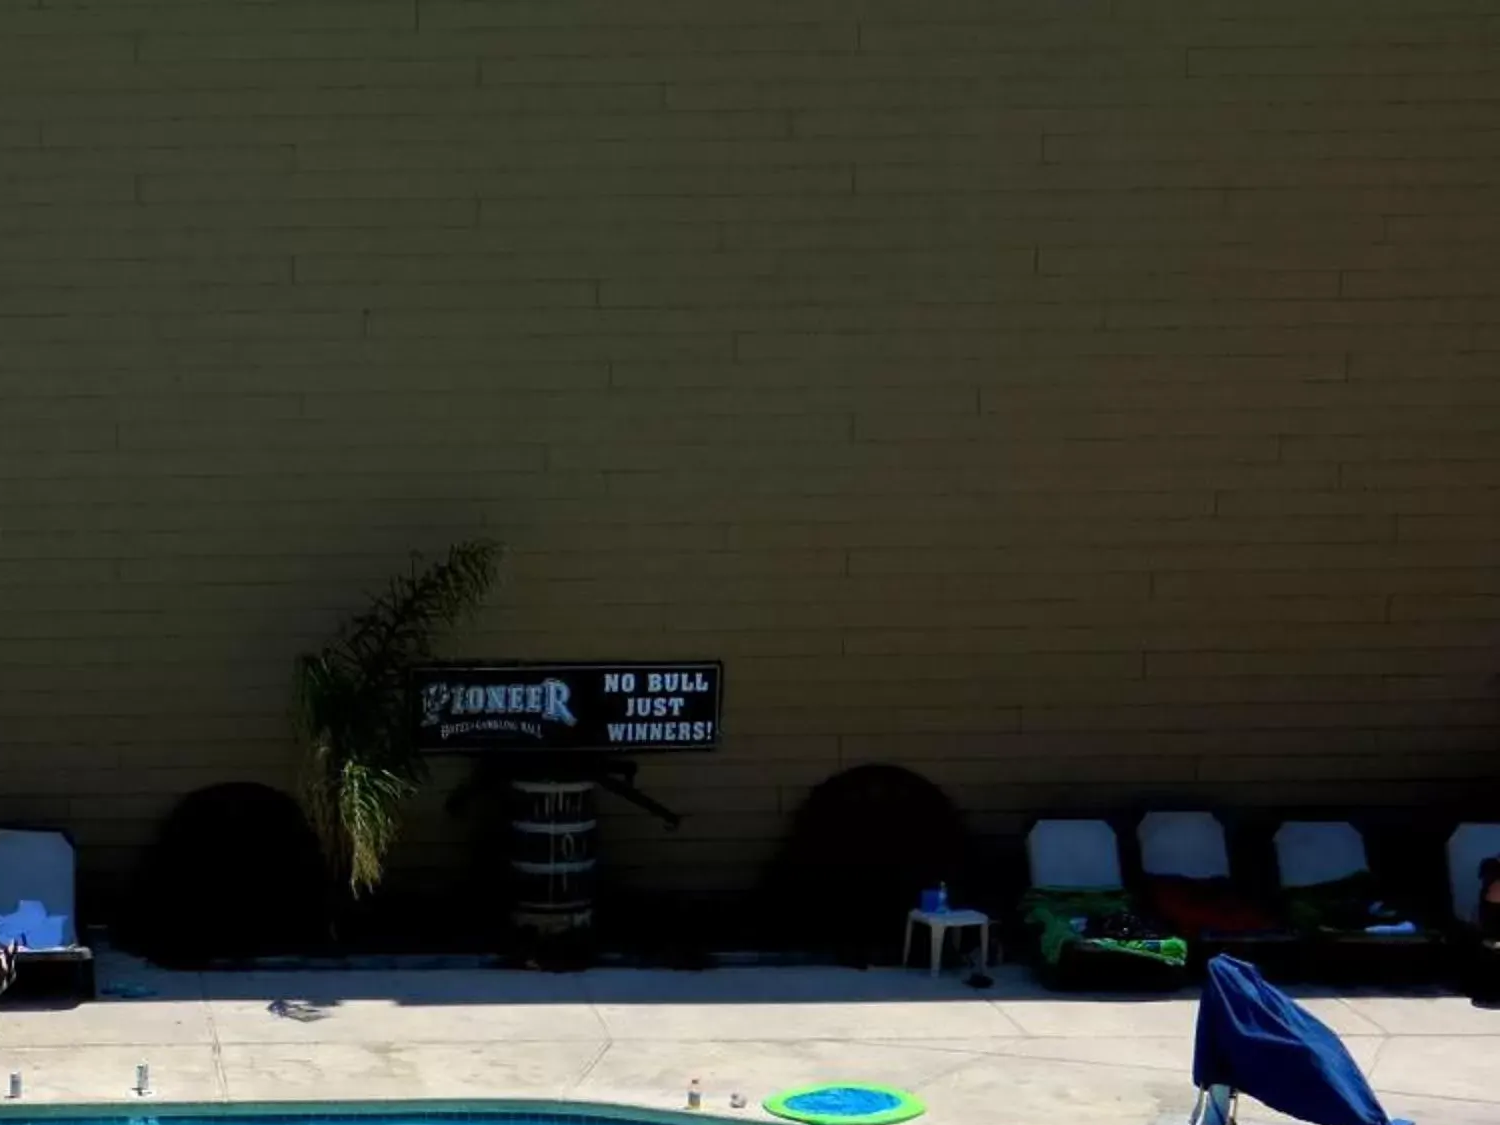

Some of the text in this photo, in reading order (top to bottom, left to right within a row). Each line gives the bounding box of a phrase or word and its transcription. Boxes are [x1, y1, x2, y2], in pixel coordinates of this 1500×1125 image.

[604, 672, 709, 693] NO BULL
[625, 696, 685, 717] JUST
[607, 720, 713, 743] WINNERS!
